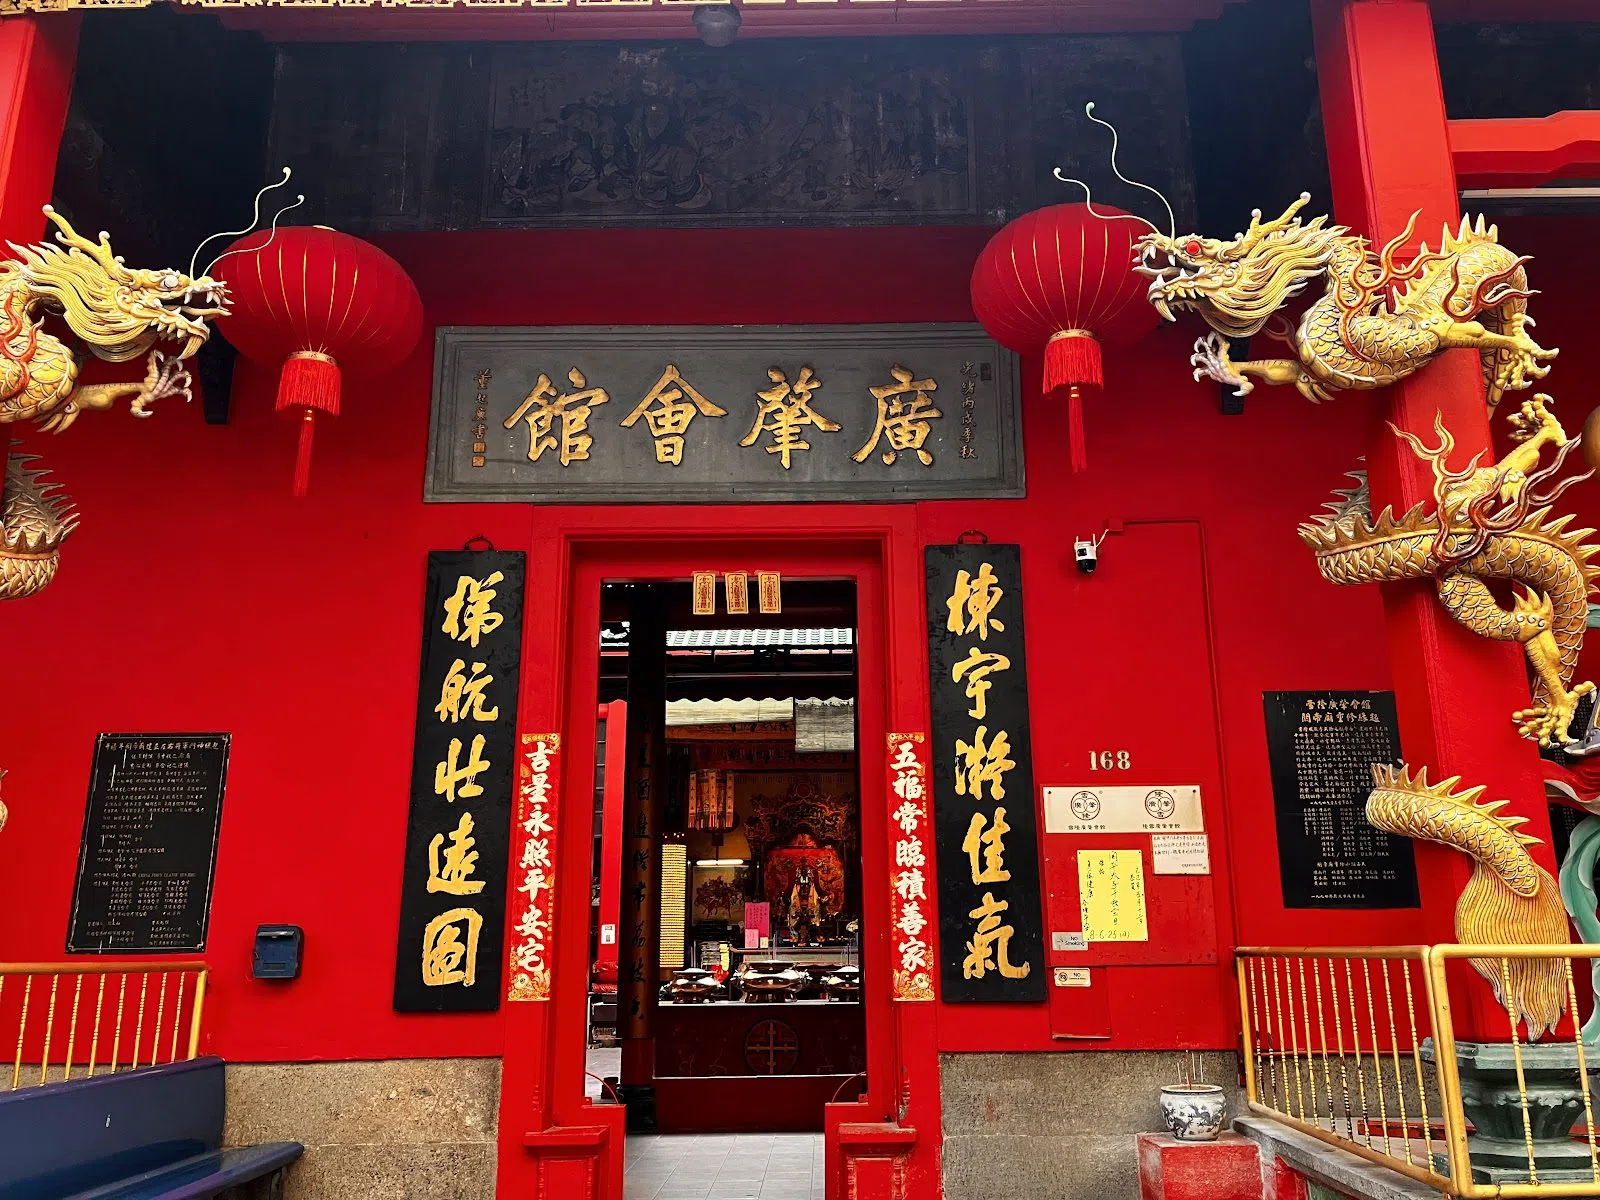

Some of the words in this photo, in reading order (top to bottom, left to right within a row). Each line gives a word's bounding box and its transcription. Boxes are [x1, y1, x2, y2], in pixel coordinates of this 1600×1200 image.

[503, 363, 943, 470] 廣肇會館
[1089, 750, 1131, 771] 168
[514, 741, 556, 973] 吉星永照平安宅
[889, 741, 928, 972] 五福常臨積善家
